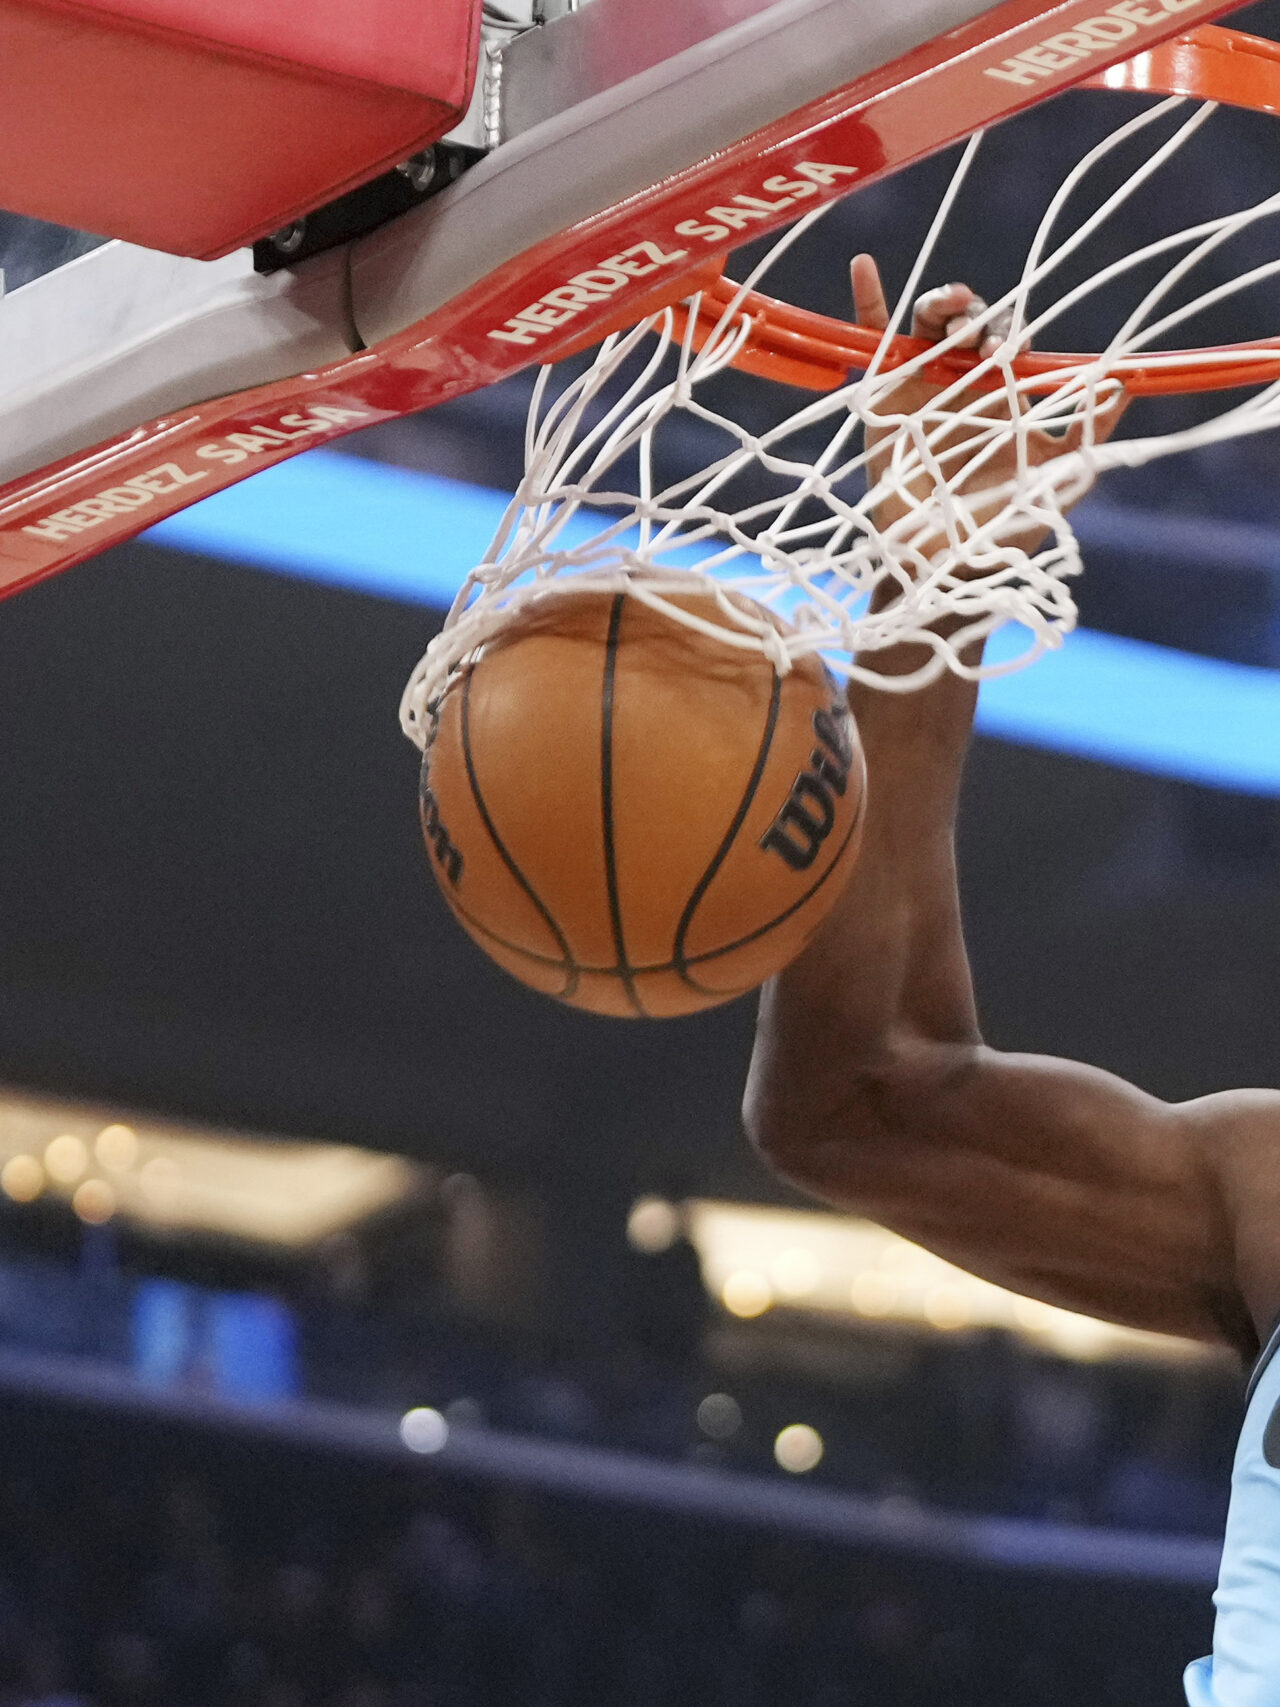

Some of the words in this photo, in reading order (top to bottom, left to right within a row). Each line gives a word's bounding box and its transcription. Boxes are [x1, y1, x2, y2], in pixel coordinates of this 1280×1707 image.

[487, 241, 688, 345] HERDEZ
[674, 160, 858, 242] SALSA
[22, 462, 209, 541] HERDEZ
[196, 405, 369, 464] SALSA
[759, 705, 852, 870] Wil
